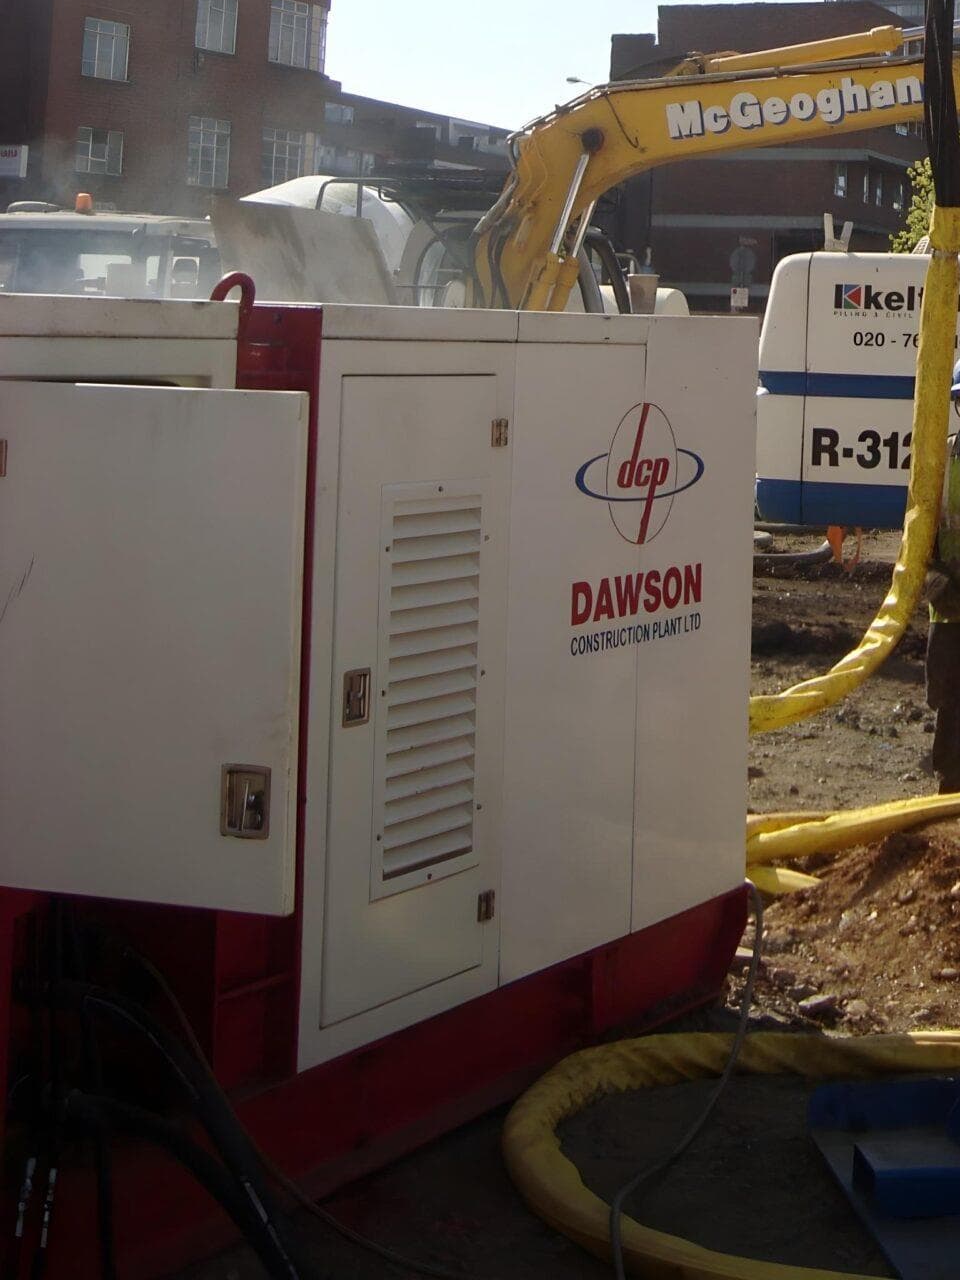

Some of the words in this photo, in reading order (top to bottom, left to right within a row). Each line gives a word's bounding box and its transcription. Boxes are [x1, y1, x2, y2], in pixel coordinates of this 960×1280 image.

[665, 75, 924, 139] McGeoghan
[853, 331, 885, 347] 020
[570, 562, 702, 626] DAWSON
[570, 623, 651, 656] CONSTRUCTION
[652, 616, 683, 640] PLANT
[684, 612, 701, 633] LTD
